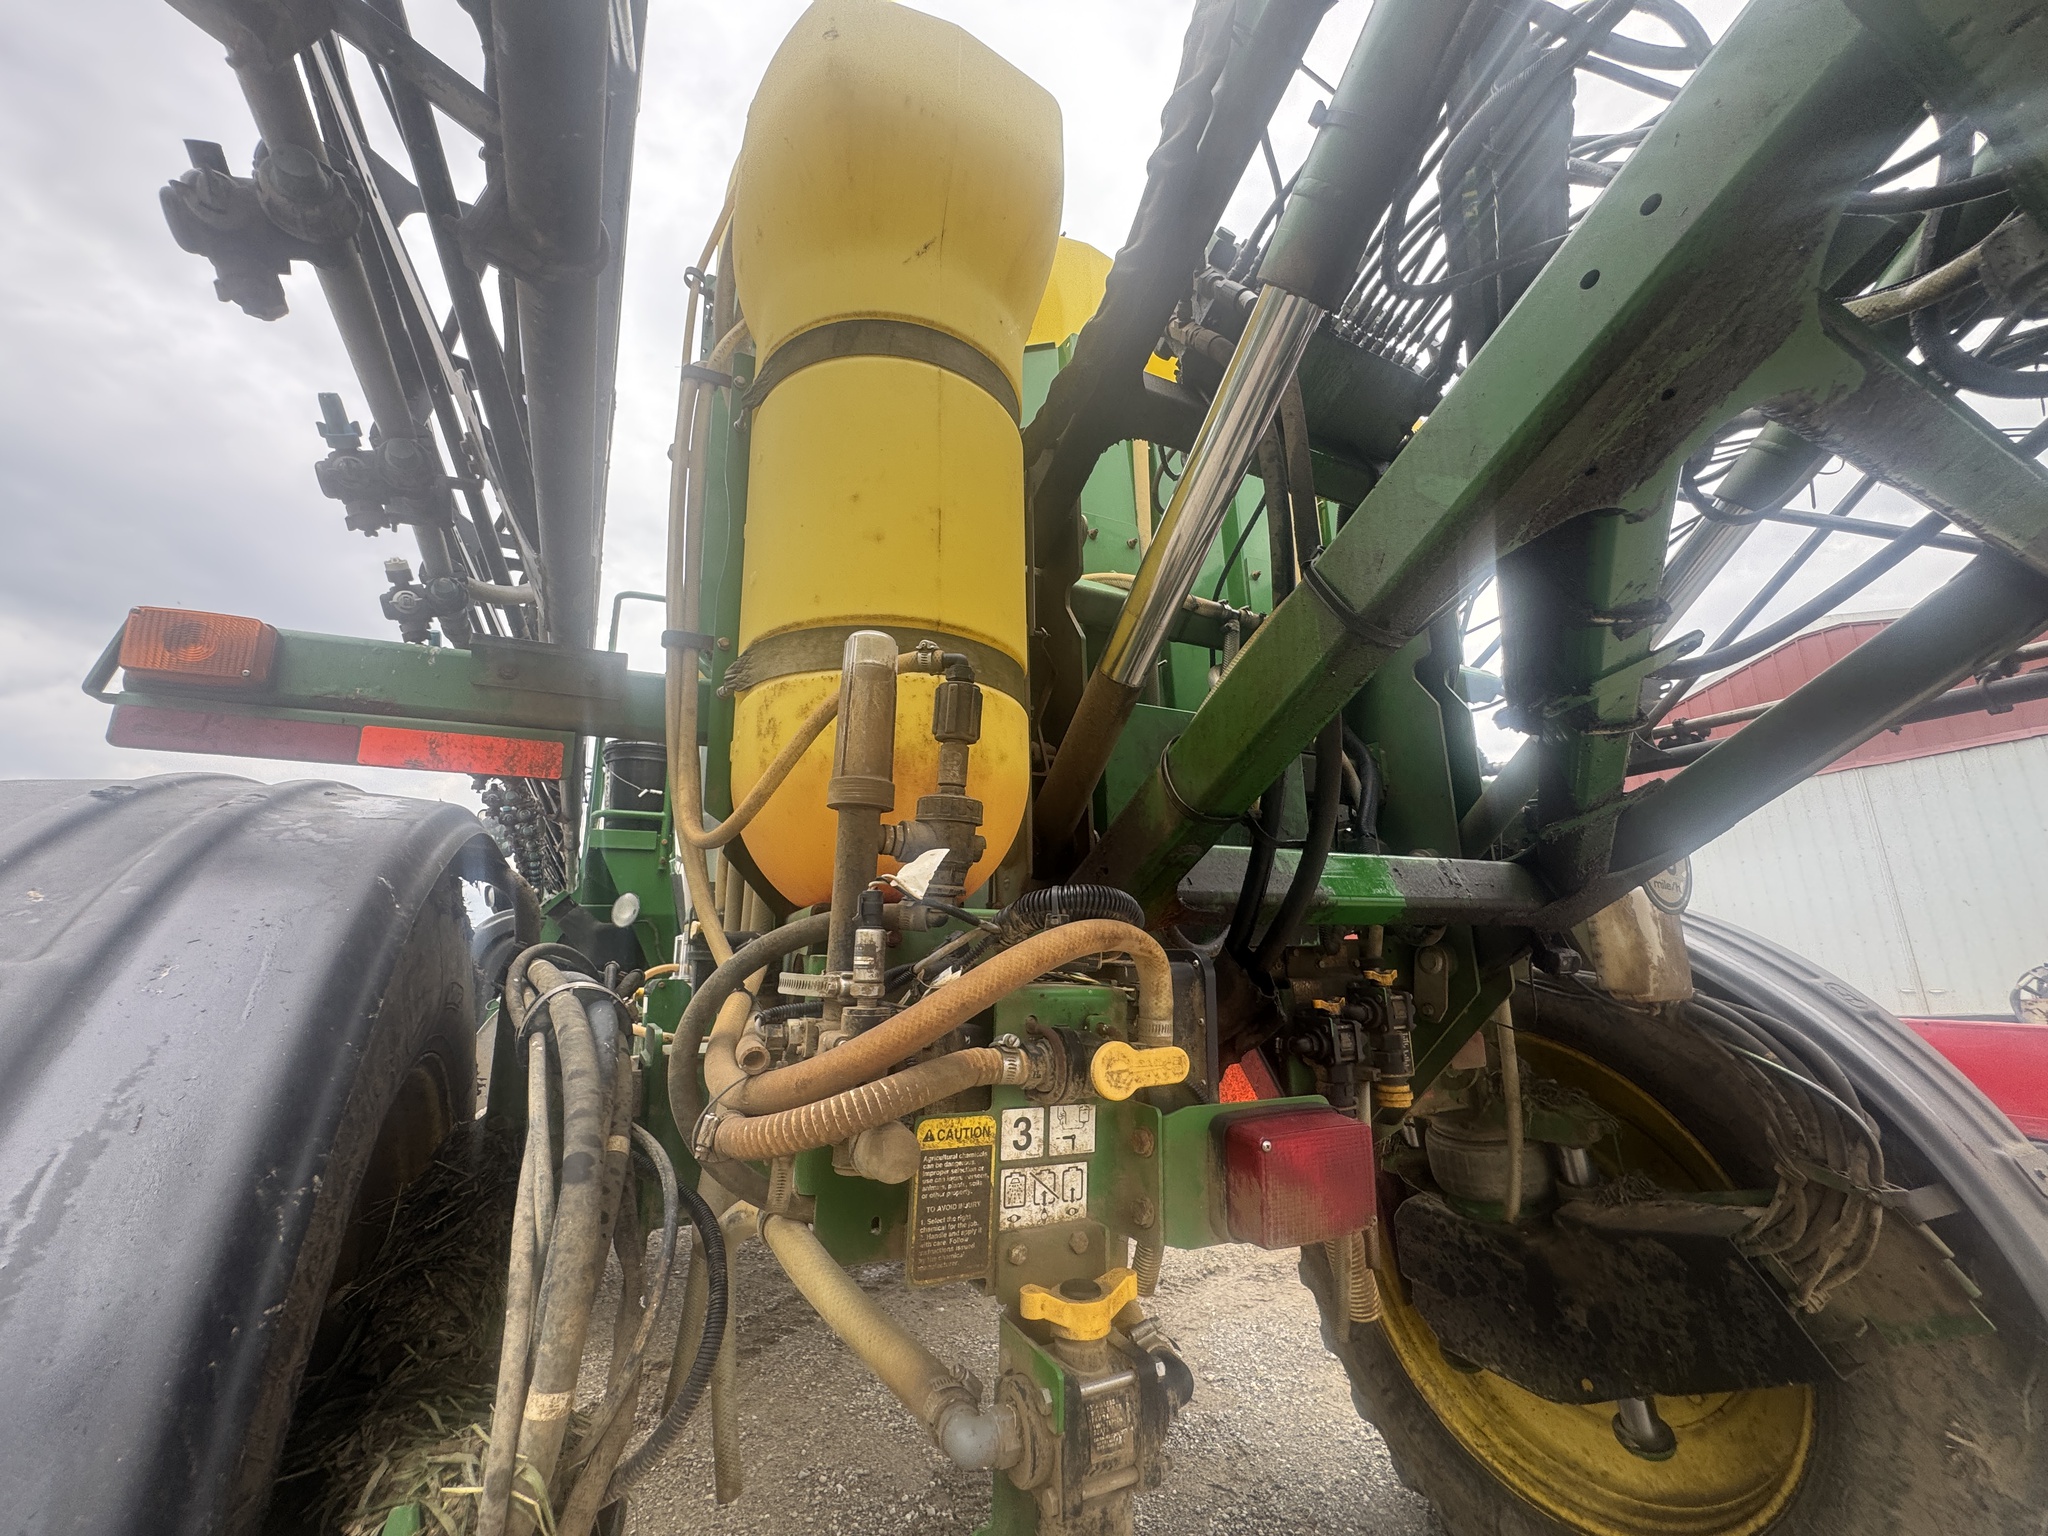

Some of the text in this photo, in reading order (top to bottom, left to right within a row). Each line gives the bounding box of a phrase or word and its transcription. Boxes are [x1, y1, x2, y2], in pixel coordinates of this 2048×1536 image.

[1653, 879, 1682, 894] mile/h
[938, 1126, 990, 1140] CAUTION
[1013, 1116, 1032, 1151] 3
[924, 1153, 958, 1163] Agricultural
[937, 1204, 957, 1212] AVOID
